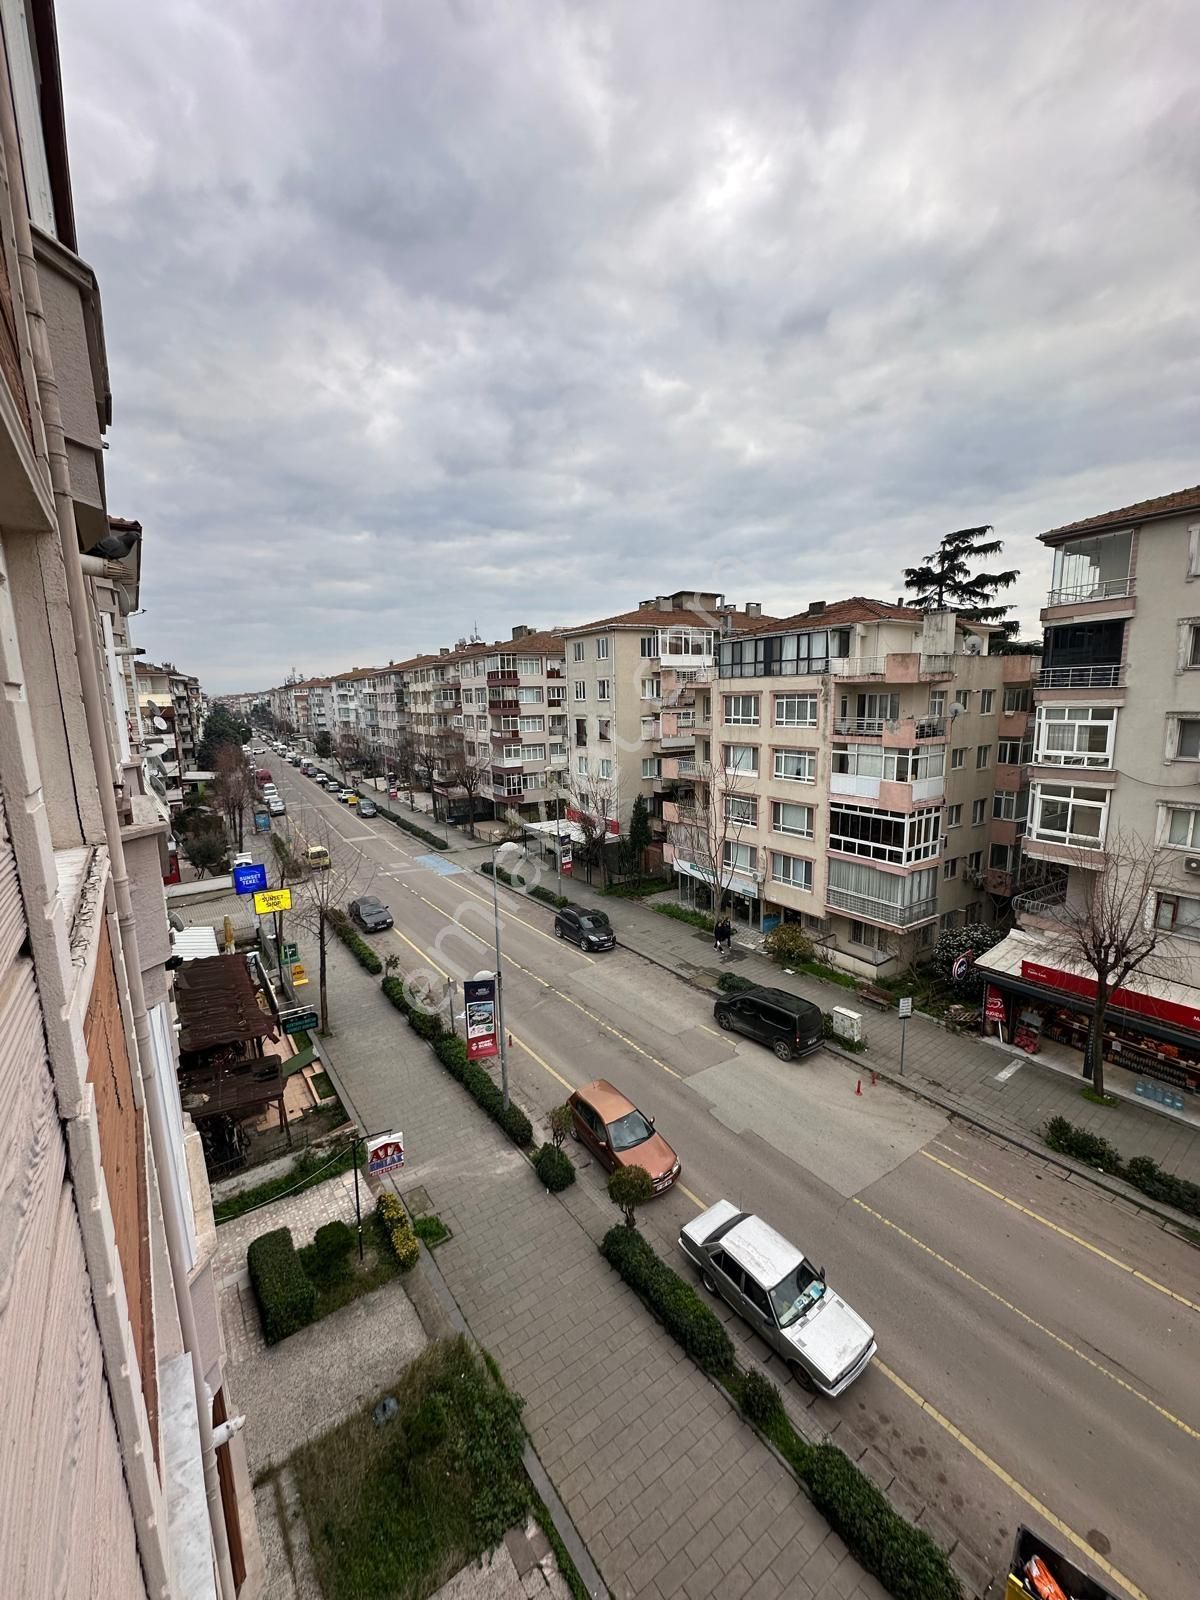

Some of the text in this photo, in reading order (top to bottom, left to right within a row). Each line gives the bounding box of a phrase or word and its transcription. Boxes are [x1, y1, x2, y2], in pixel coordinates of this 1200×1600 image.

[239, 873, 261, 882] SUNSET
[261, 894, 284, 903] SUNSET
[265, 900, 282, 908] SHOP
